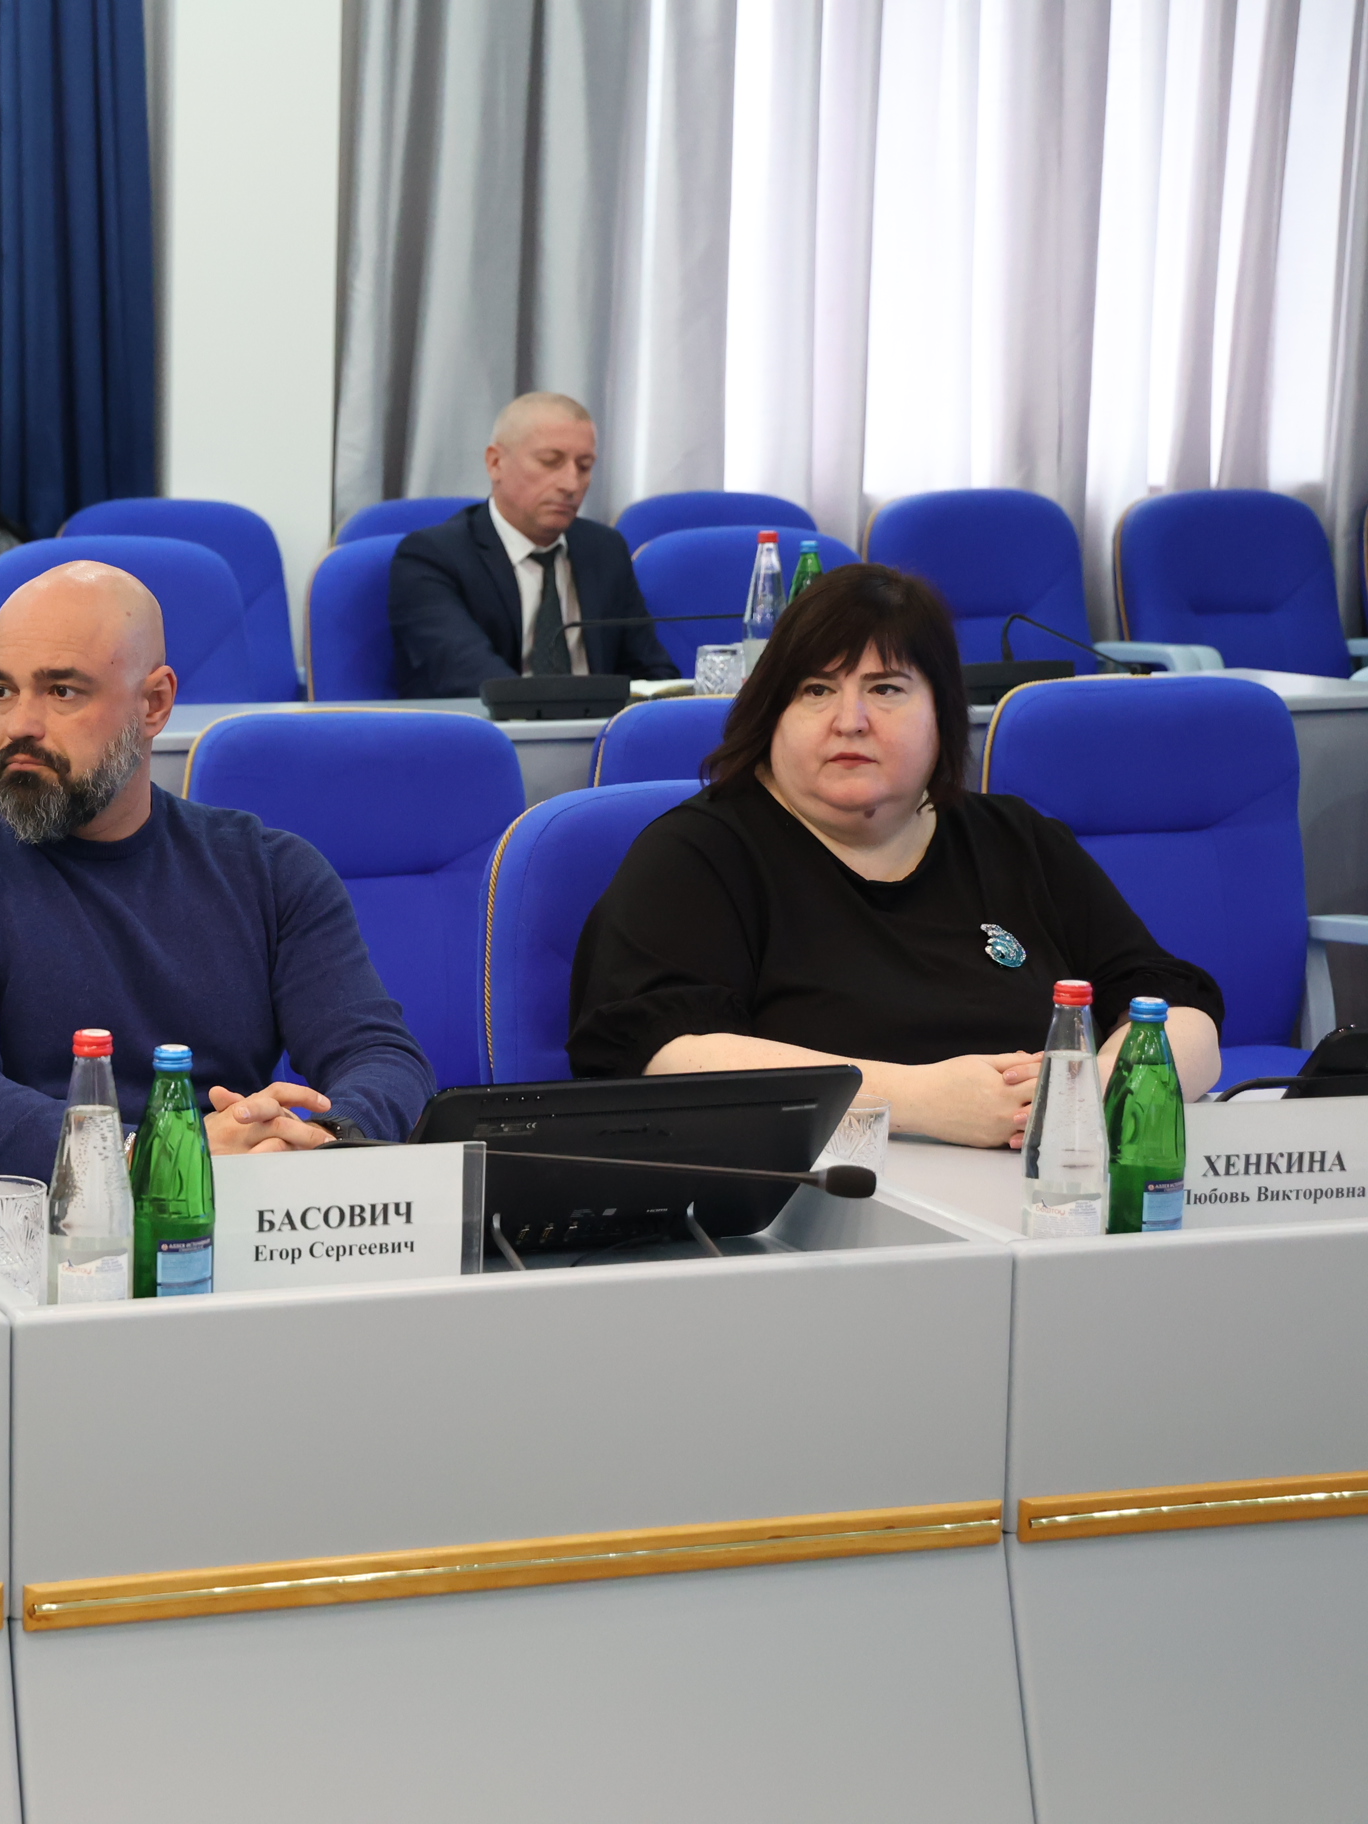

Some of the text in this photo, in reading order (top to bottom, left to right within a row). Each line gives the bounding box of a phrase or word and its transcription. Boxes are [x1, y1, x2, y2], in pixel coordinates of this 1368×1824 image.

[1202, 1150, 1347, 1178] ХЕНКИНА
[1256, 1185, 1366, 1205] Викторовна
[256, 1201, 414, 1233] БАСОВИЧ
[253, 1240, 415, 1265] Егор Сергеевич
